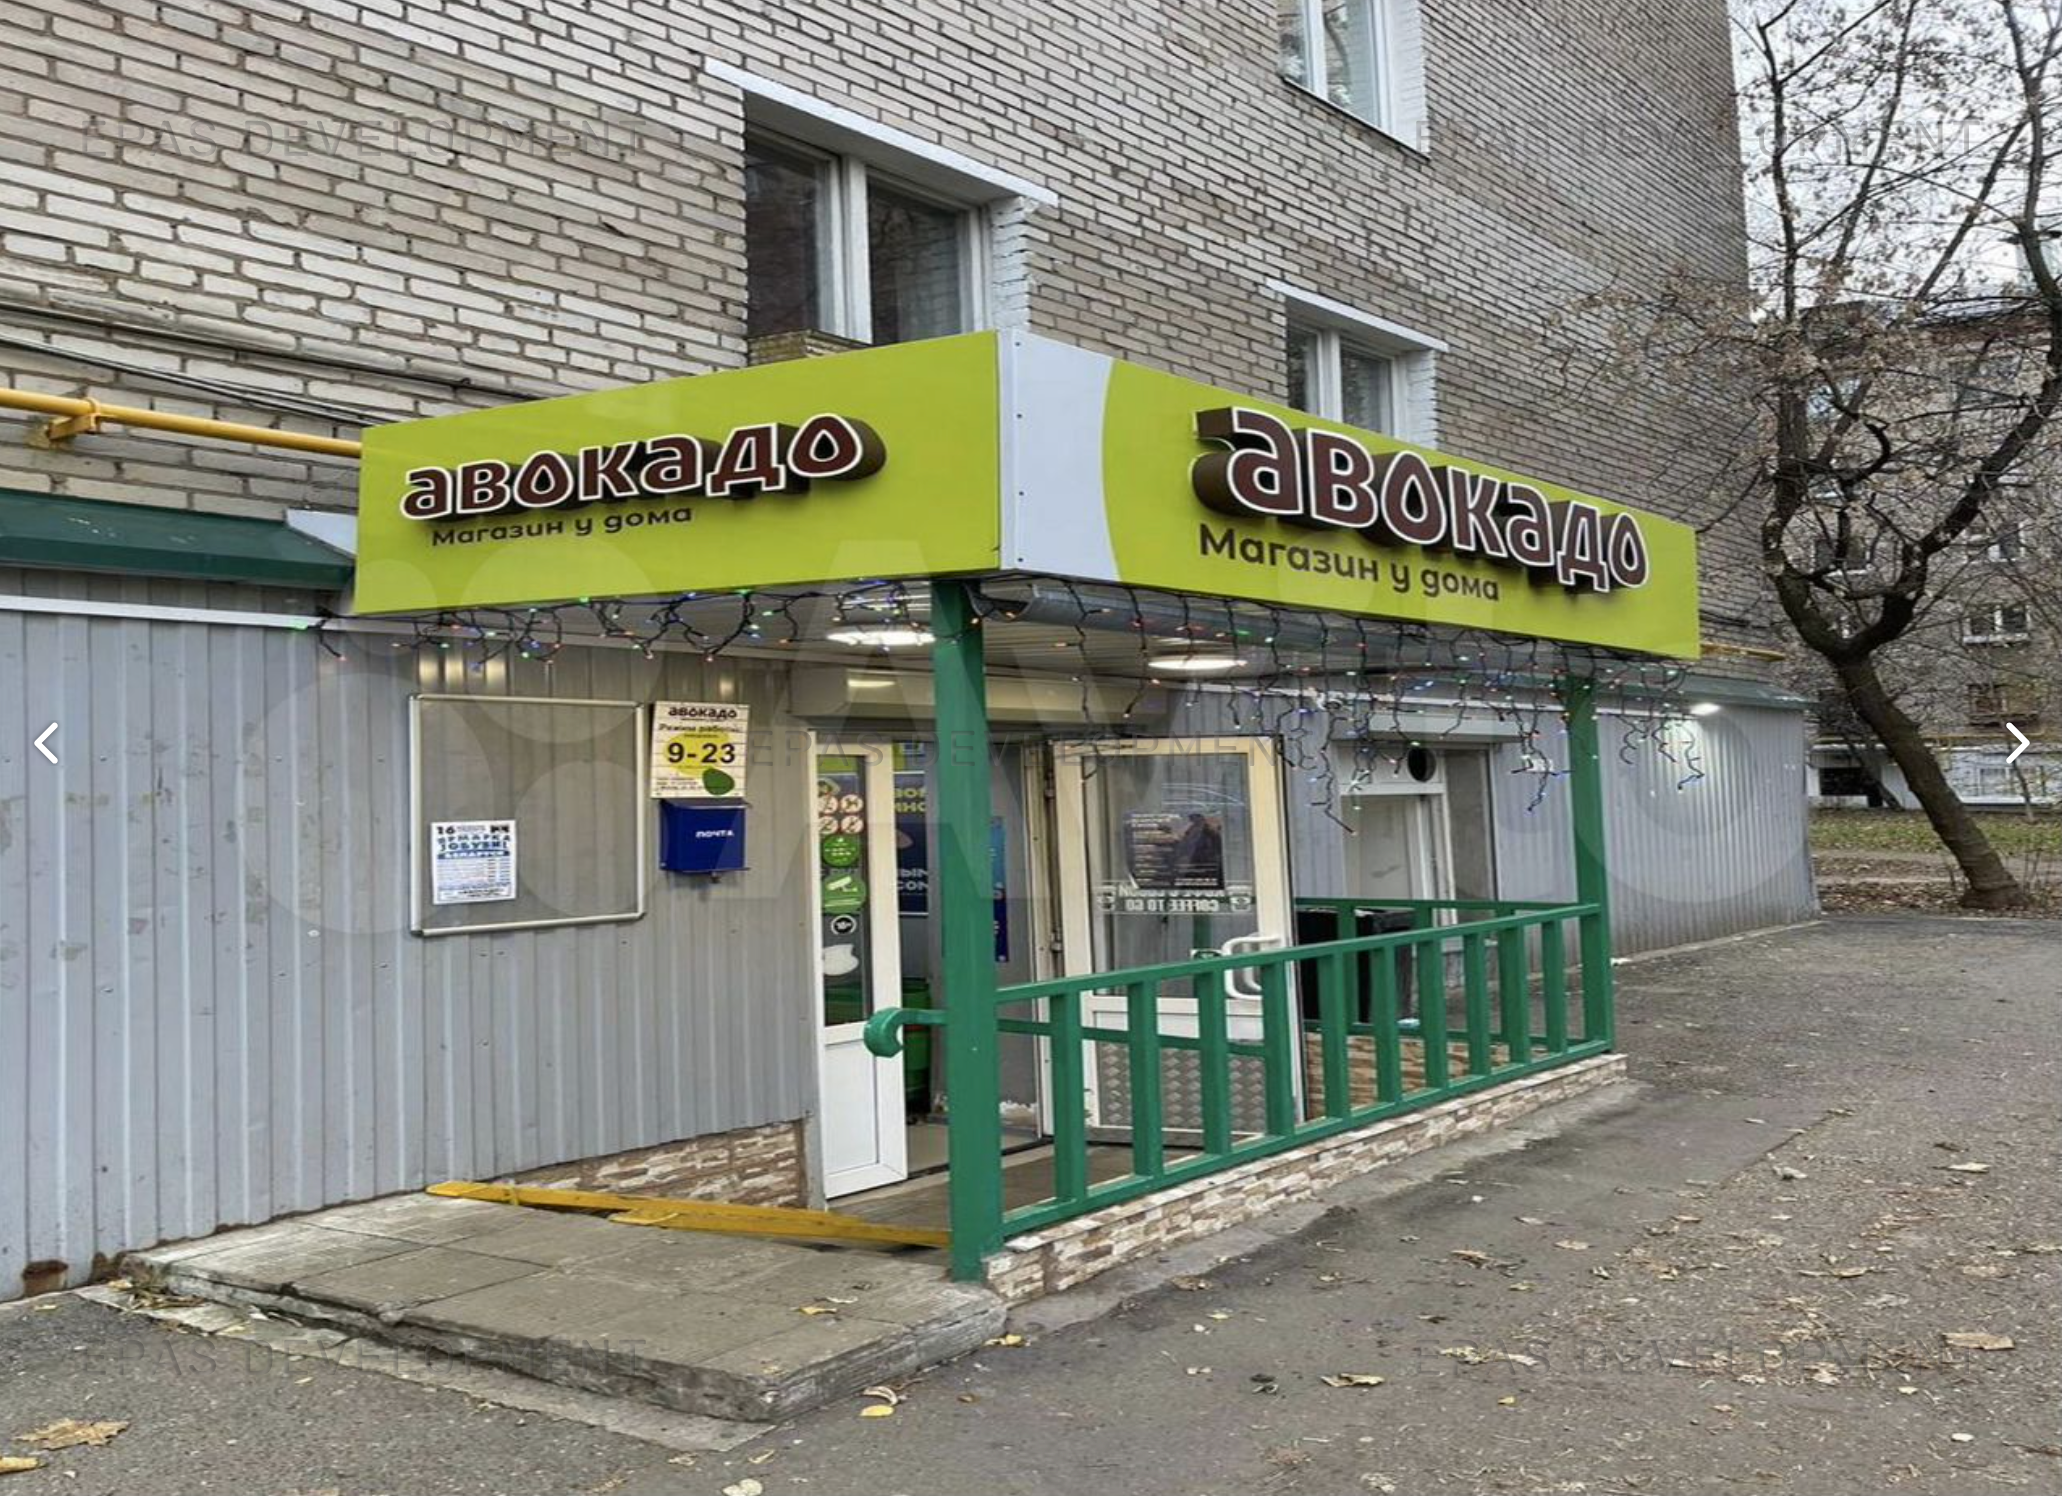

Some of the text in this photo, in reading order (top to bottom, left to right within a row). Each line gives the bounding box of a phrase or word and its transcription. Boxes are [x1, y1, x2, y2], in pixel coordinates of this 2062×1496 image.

[400, 412, 864, 520] авокадо
[1224, 405, 1650, 593] авокадо
[431, 506, 693, 547] Магазин у дома
[1199, 522, 1500, 601] Магазин у дома
[668, 705, 738, 719] авокадо
